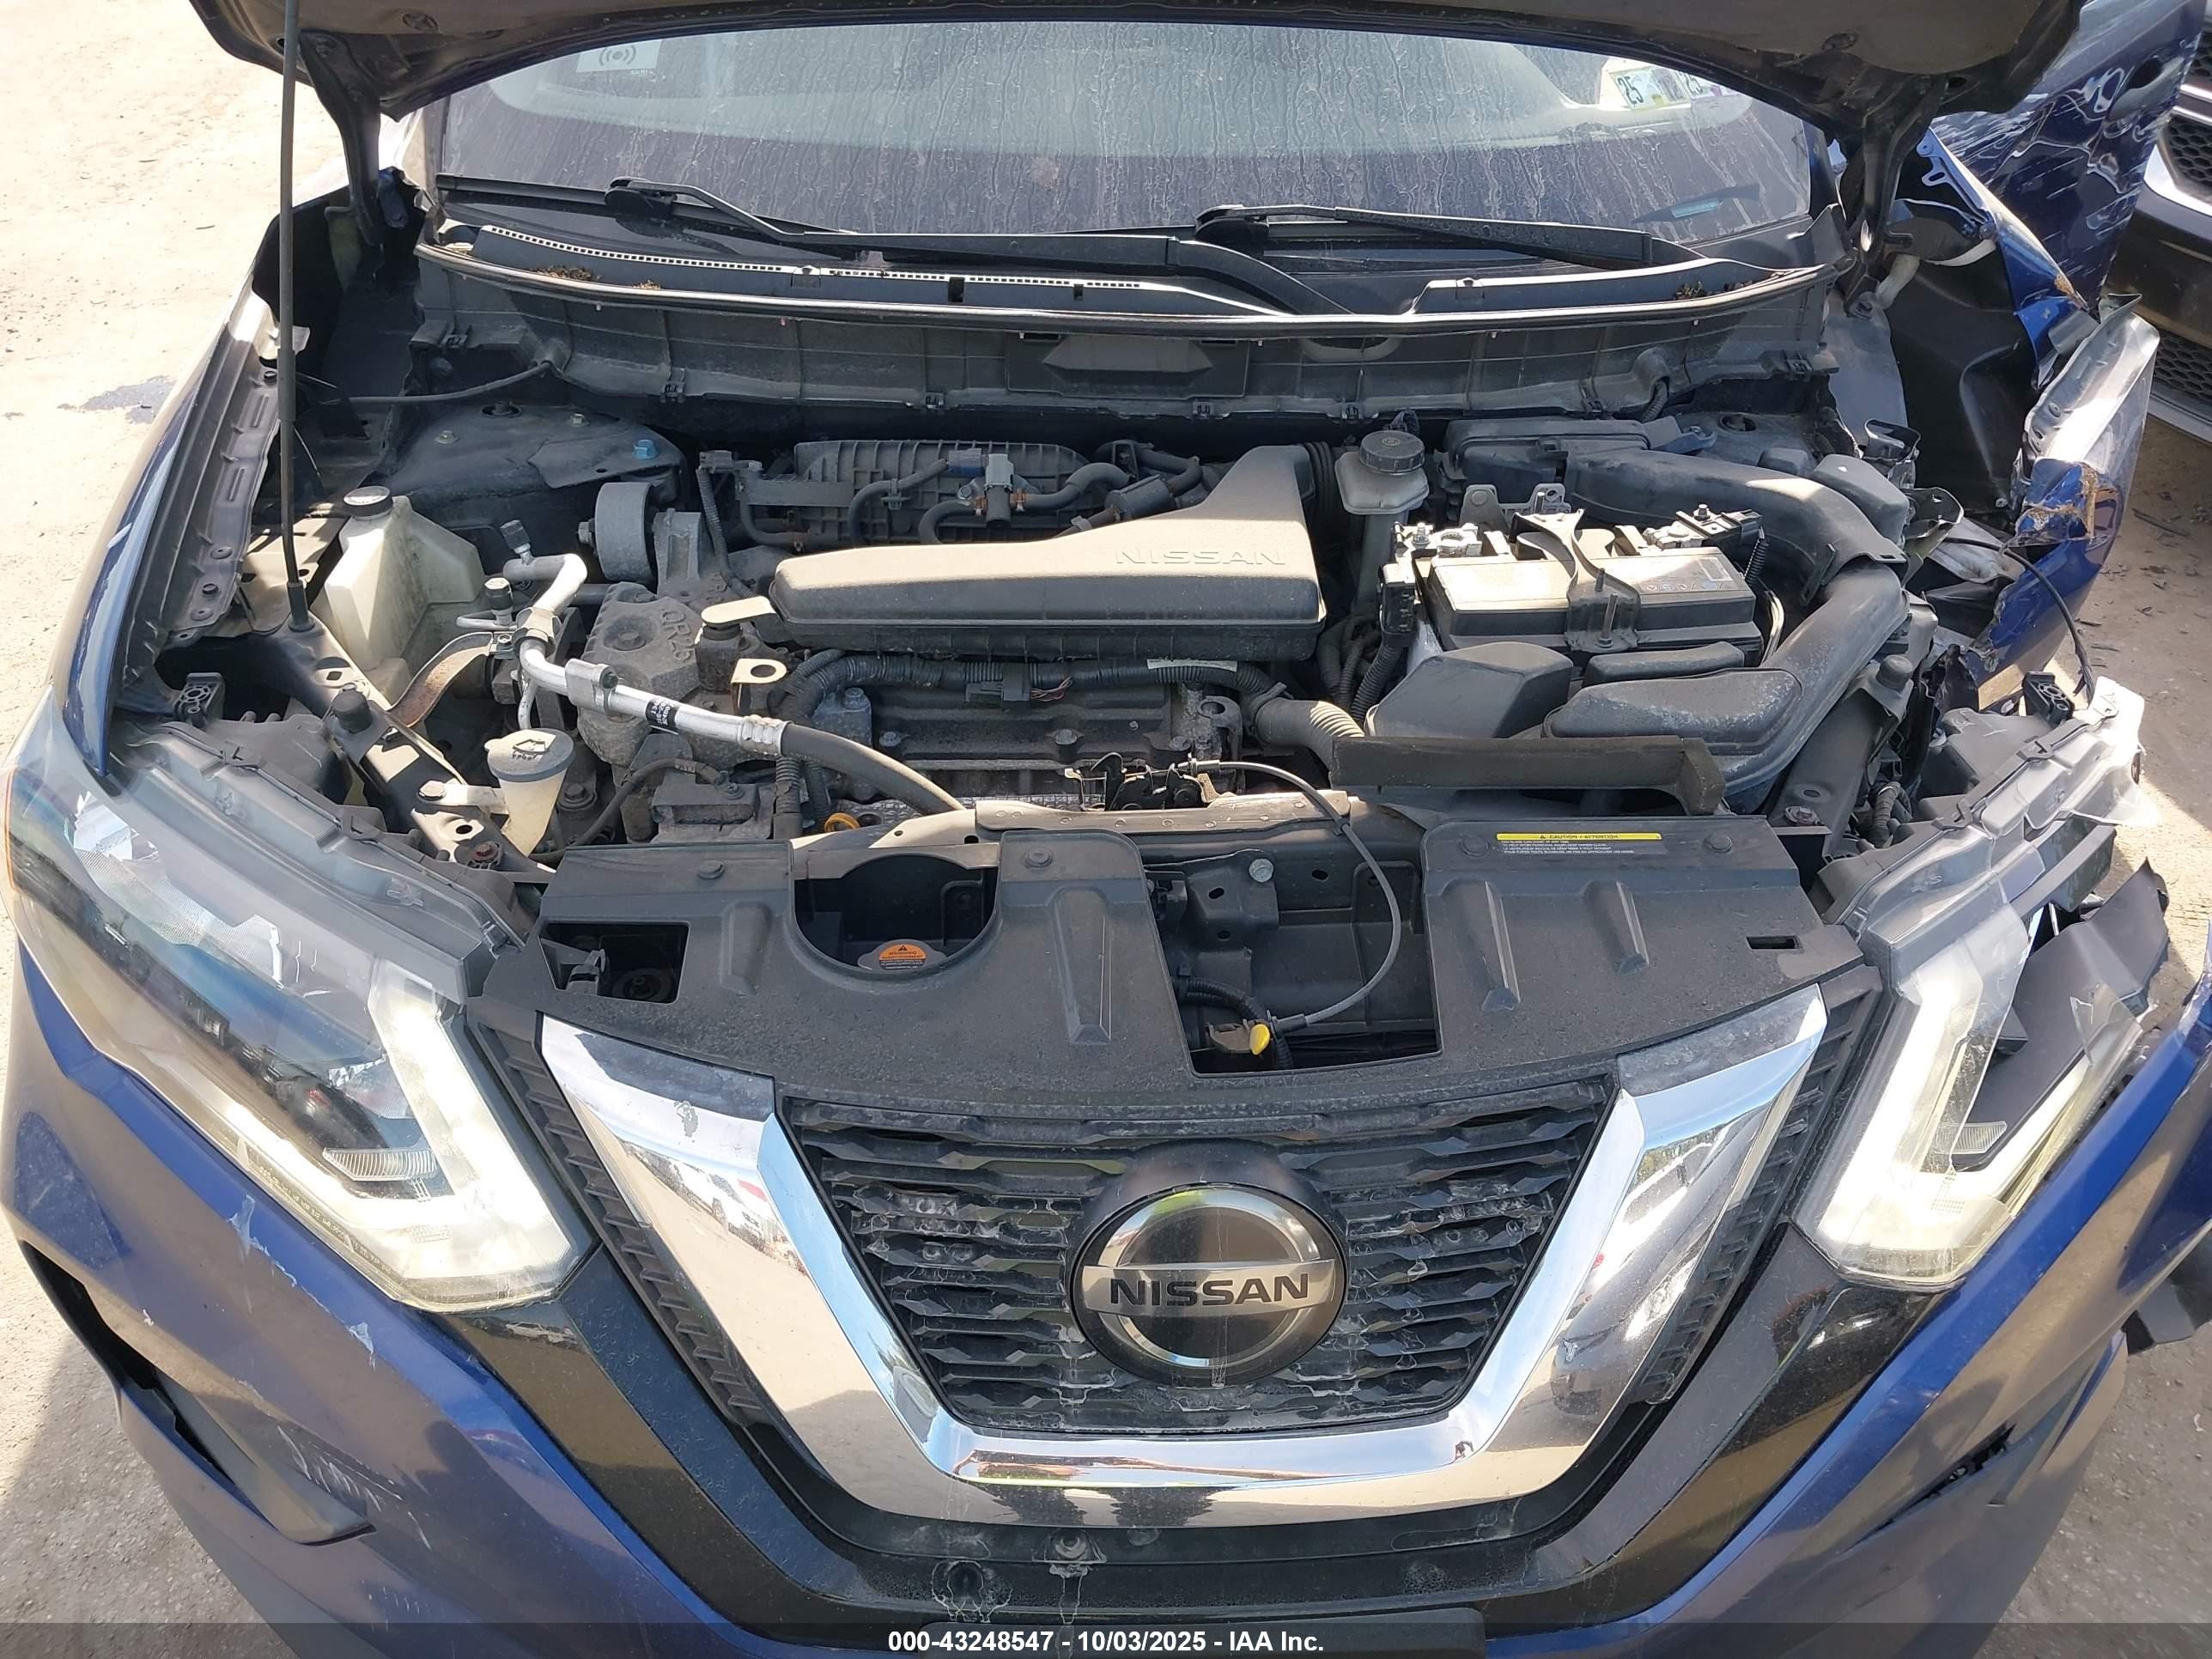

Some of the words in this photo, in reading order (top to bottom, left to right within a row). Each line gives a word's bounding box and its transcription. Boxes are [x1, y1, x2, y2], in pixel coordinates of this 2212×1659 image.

[1617, 76, 1644, 105] 25
[1116, 548, 1286, 565] NISSAN
[660, 611, 696, 663] QR25
[1110, 1273, 1309, 1307] NISSAN
